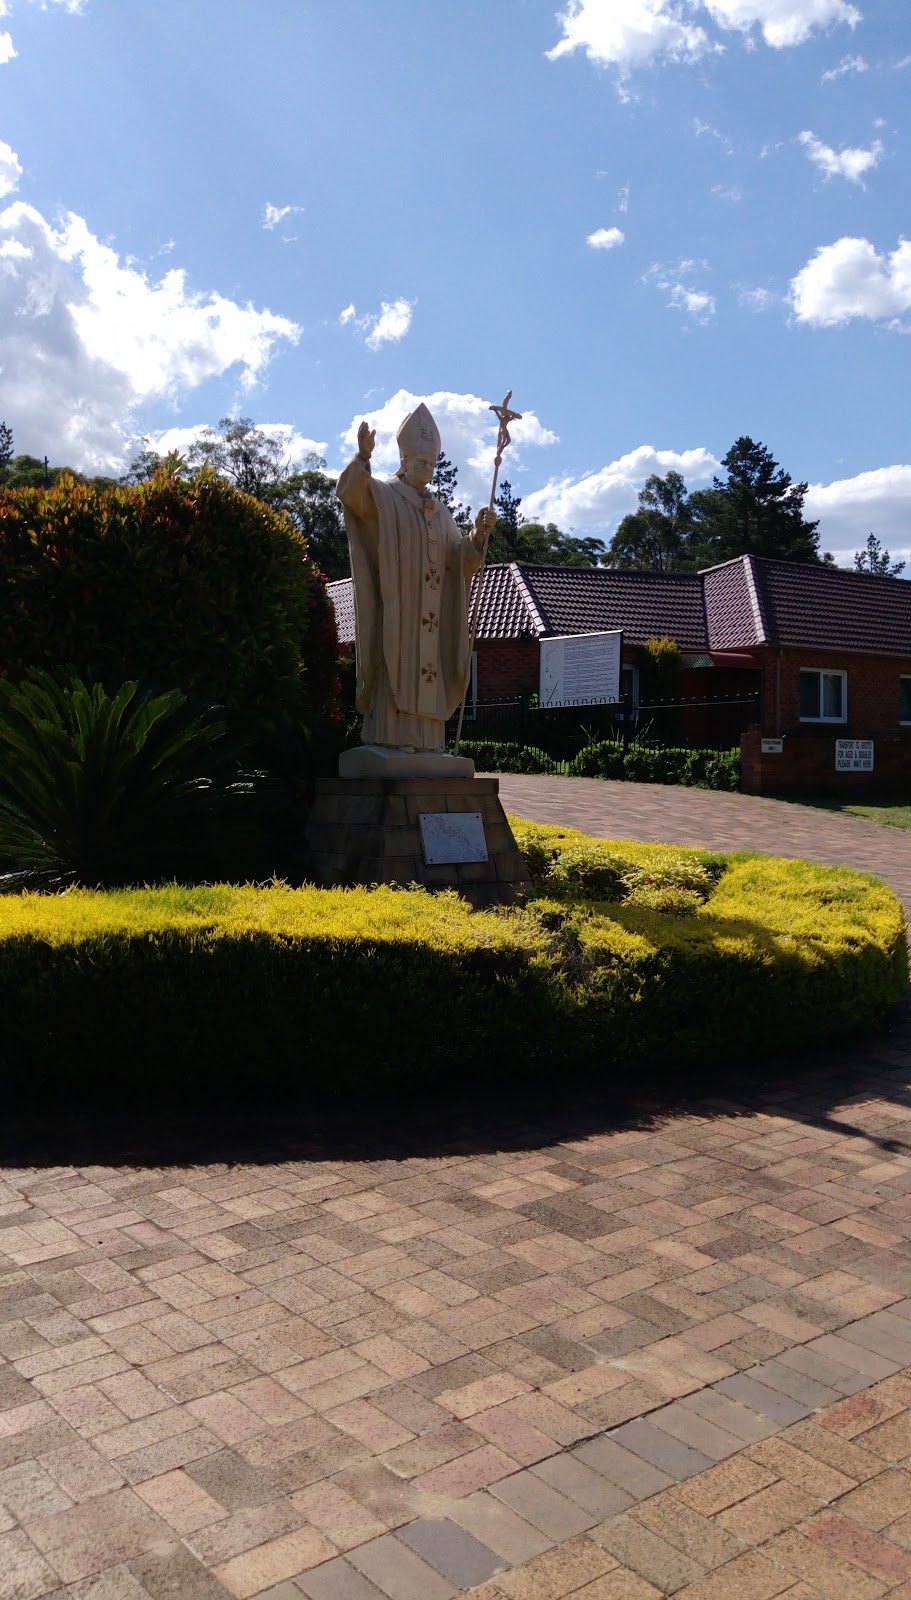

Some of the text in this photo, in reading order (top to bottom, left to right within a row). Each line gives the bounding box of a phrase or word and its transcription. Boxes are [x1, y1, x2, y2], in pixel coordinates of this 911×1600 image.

[838, 741, 854, 749] TRANSPORT
[855, 741, 860, 749] TO
[845, 750, 854, 759] AGED
[858, 750, 872, 759] DISABLED
[838, 759, 872, 768] PLEASE WAIT HERE
